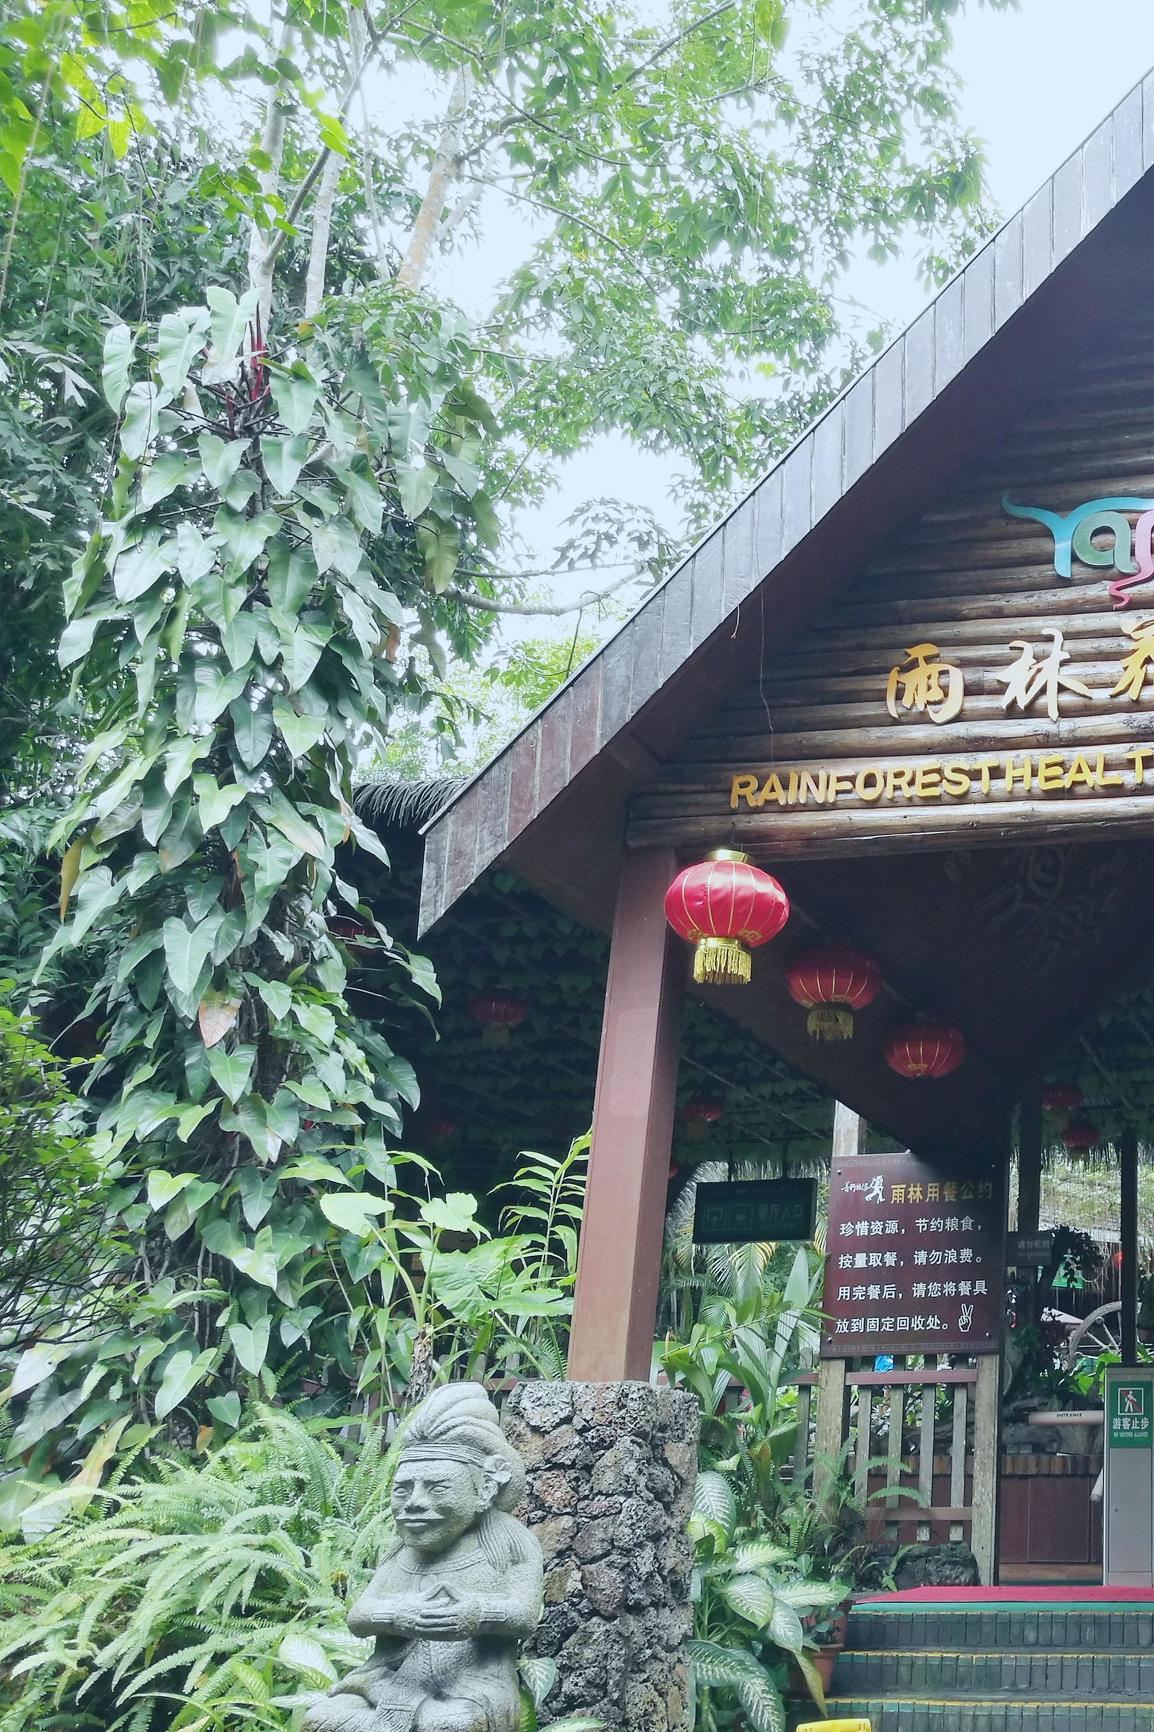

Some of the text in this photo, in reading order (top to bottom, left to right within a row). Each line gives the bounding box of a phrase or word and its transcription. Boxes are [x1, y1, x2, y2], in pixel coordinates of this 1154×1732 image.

[890, 1180, 993, 1204] 雨林用餐公约
[835, 1314, 949, 1334] 放到固定回收处。
[1112, 1417, 1150, 1430] 游客止步
